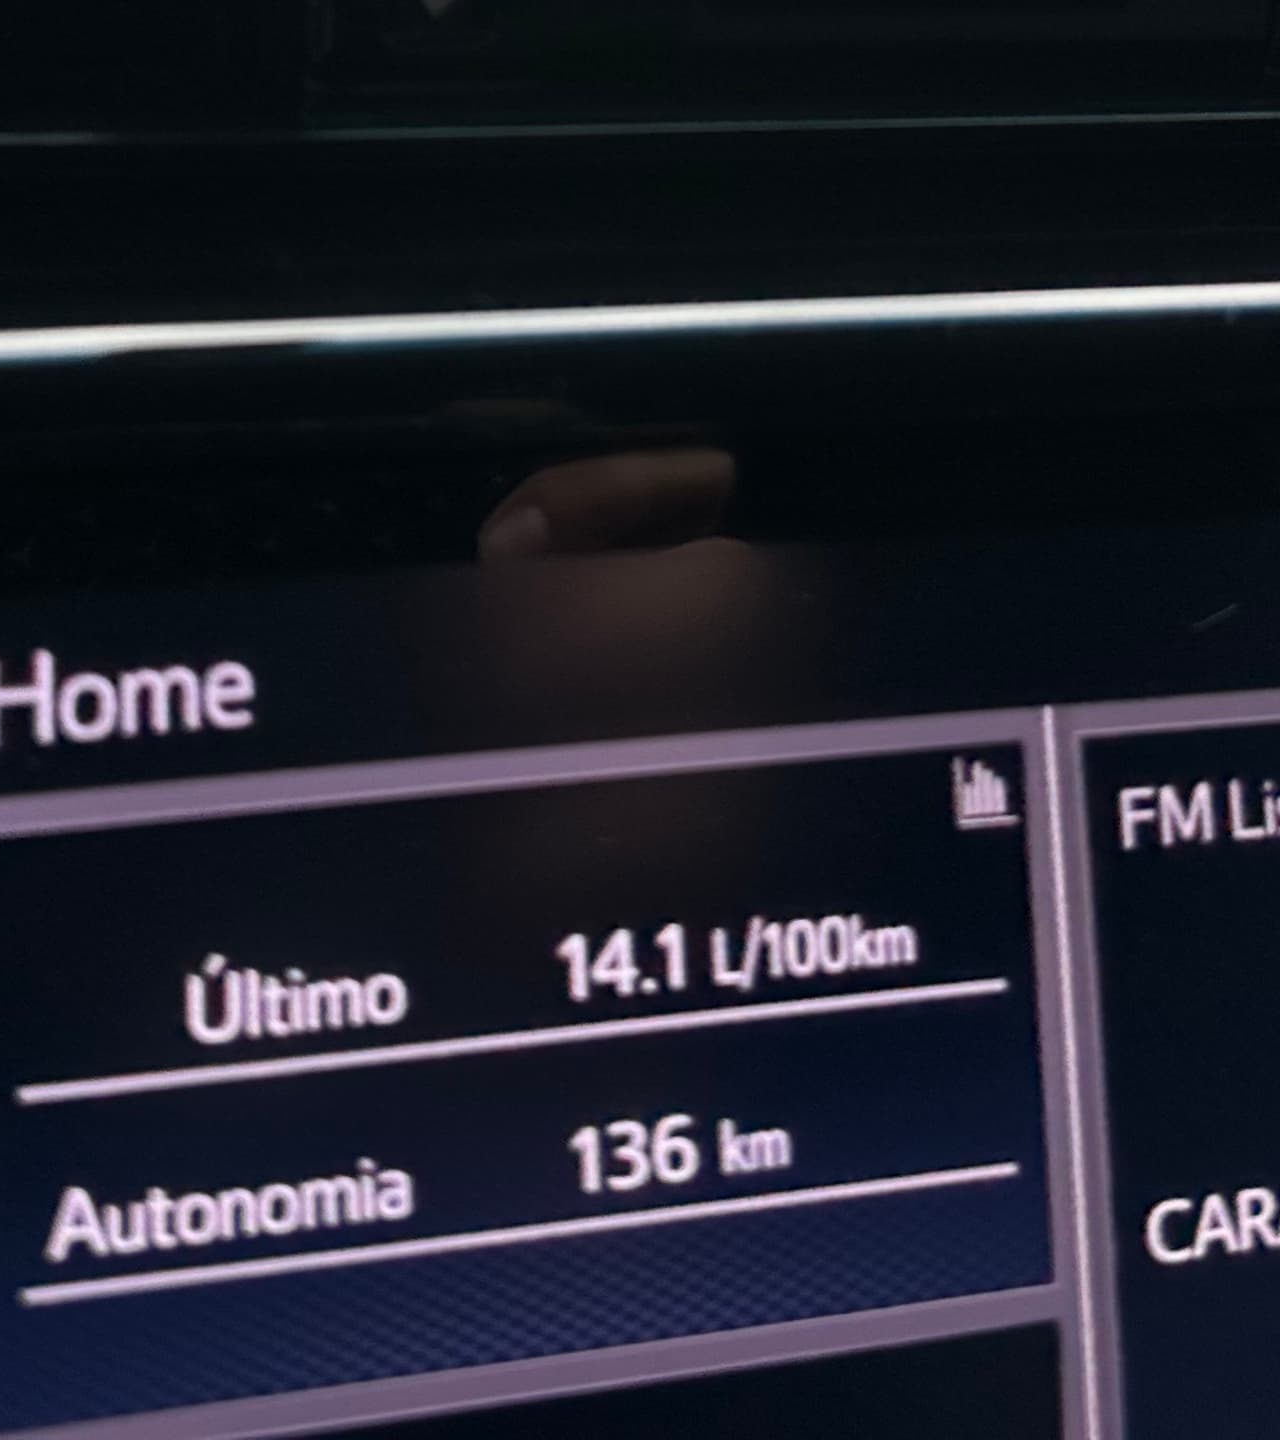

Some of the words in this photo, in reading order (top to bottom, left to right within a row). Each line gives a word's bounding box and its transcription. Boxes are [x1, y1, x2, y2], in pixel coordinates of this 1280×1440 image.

[1120, 782, 1216, 848] FM
[185, 955, 408, 1047] Último
[557, 923, 690, 1001] 14.1
[710, 914, 919, 991] L/100km
[44, 1159, 414, 1262] Autonomia
[568, 1114, 700, 1195] 136
[719, 1120, 793, 1175] km
